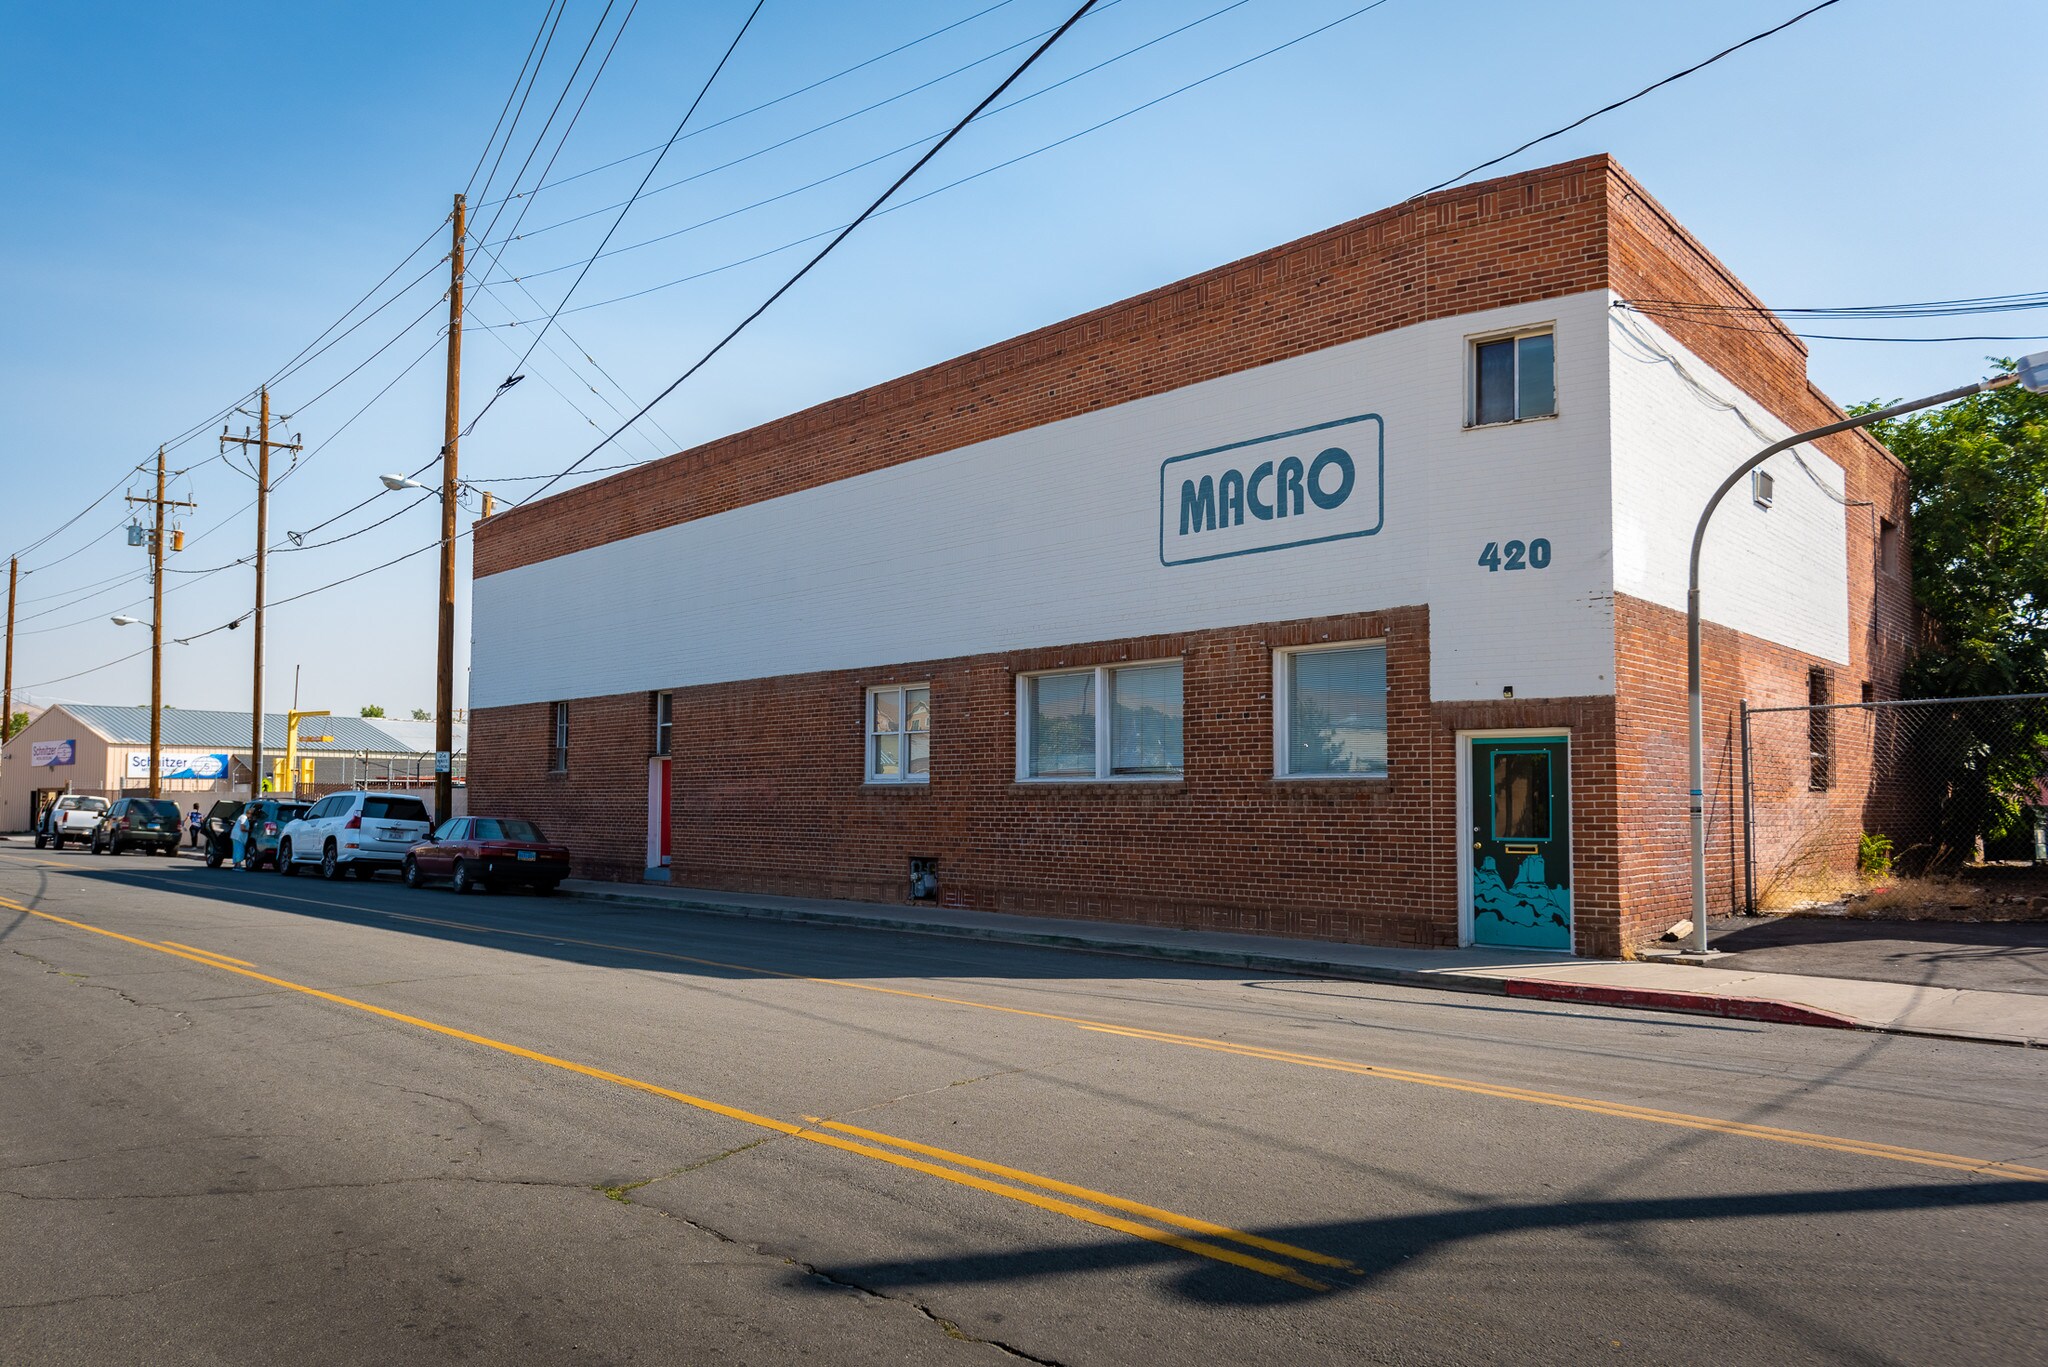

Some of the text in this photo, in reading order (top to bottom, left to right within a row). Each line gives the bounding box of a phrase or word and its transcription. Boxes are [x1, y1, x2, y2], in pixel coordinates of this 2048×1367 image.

[1179, 446, 1356, 536] MACRO
[1477, 538, 1551, 572] 420
[132, 756, 187, 768] Schitzer
